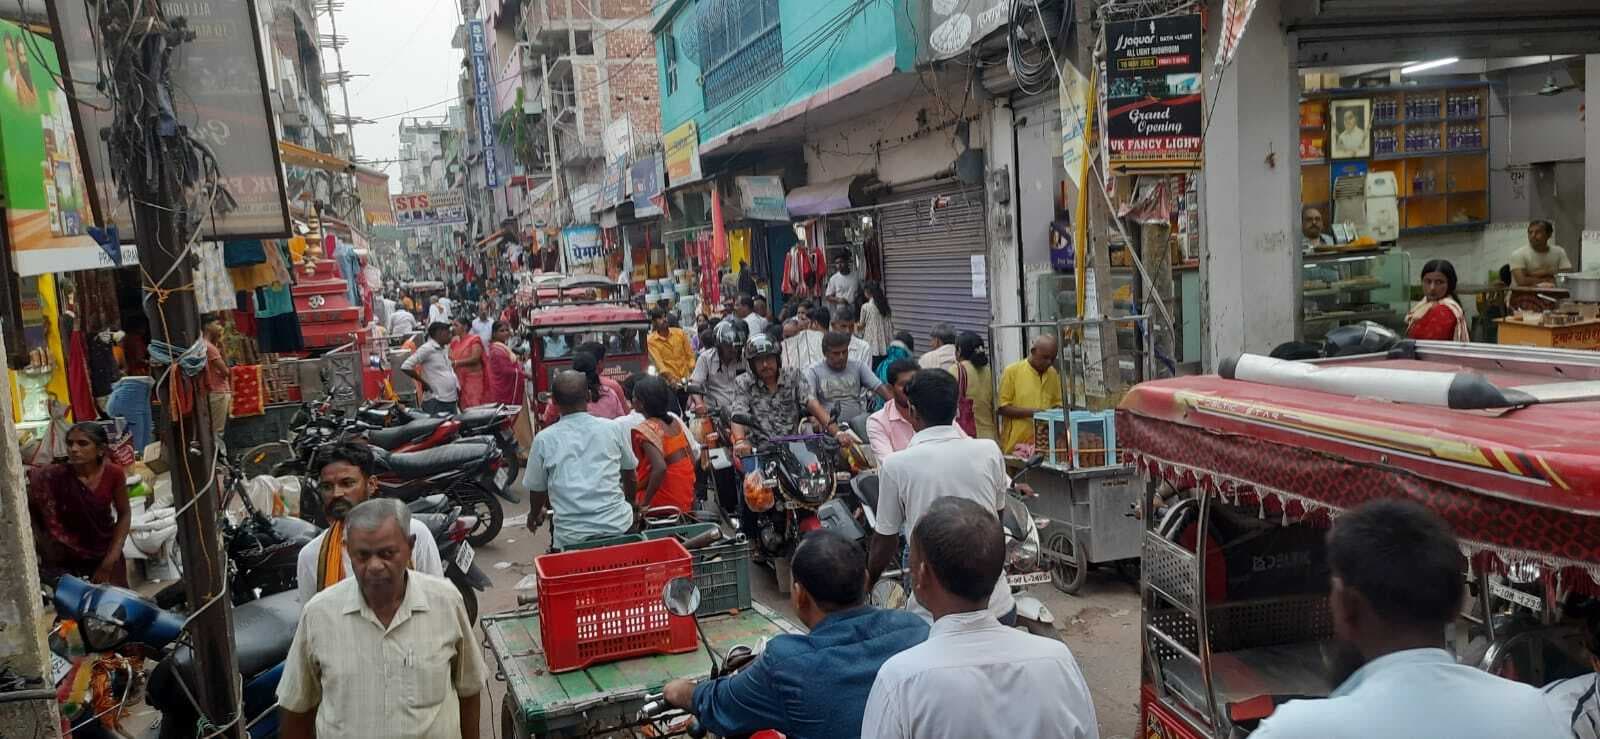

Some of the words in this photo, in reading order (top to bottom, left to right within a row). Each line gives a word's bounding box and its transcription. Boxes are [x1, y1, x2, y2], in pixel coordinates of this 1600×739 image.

[472, 25, 482, 52] STS
[1126, 48, 1136, 57] ALL
[1136, 47, 1151, 56] LIGHT
[1151, 45, 1180, 55] SHOWROOM
[1128, 106, 1170, 124] Grand
[1137, 120, 1183, 136] Opening
[1110, 140, 1125, 151] VK
[1127, 139, 1163, 150] FANCY
[1165, 137, 1200, 149] LIGHT
[396, 194, 429, 210] STS
